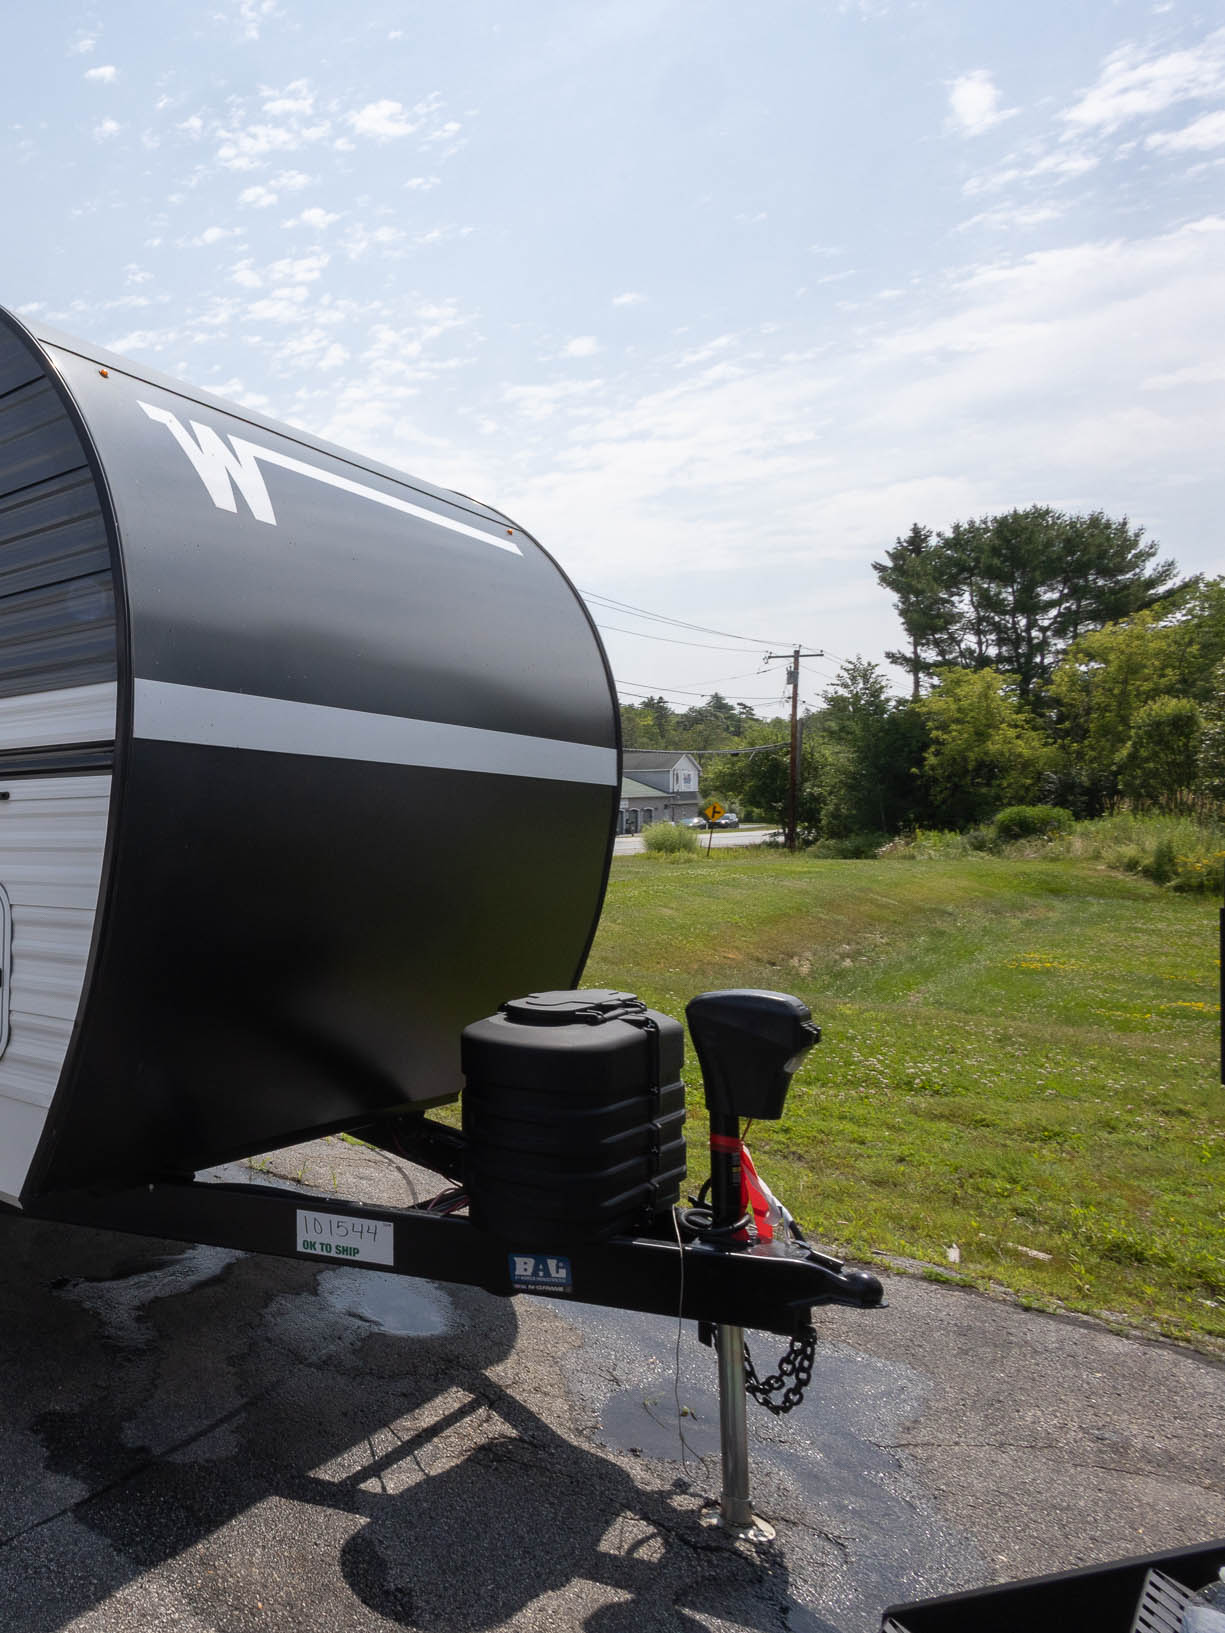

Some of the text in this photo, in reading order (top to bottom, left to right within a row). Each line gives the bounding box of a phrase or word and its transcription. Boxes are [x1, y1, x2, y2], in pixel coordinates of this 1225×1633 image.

[303, 1215, 378, 1242] 101544
[302, 1240, 360, 1257] OK TO SHIP
